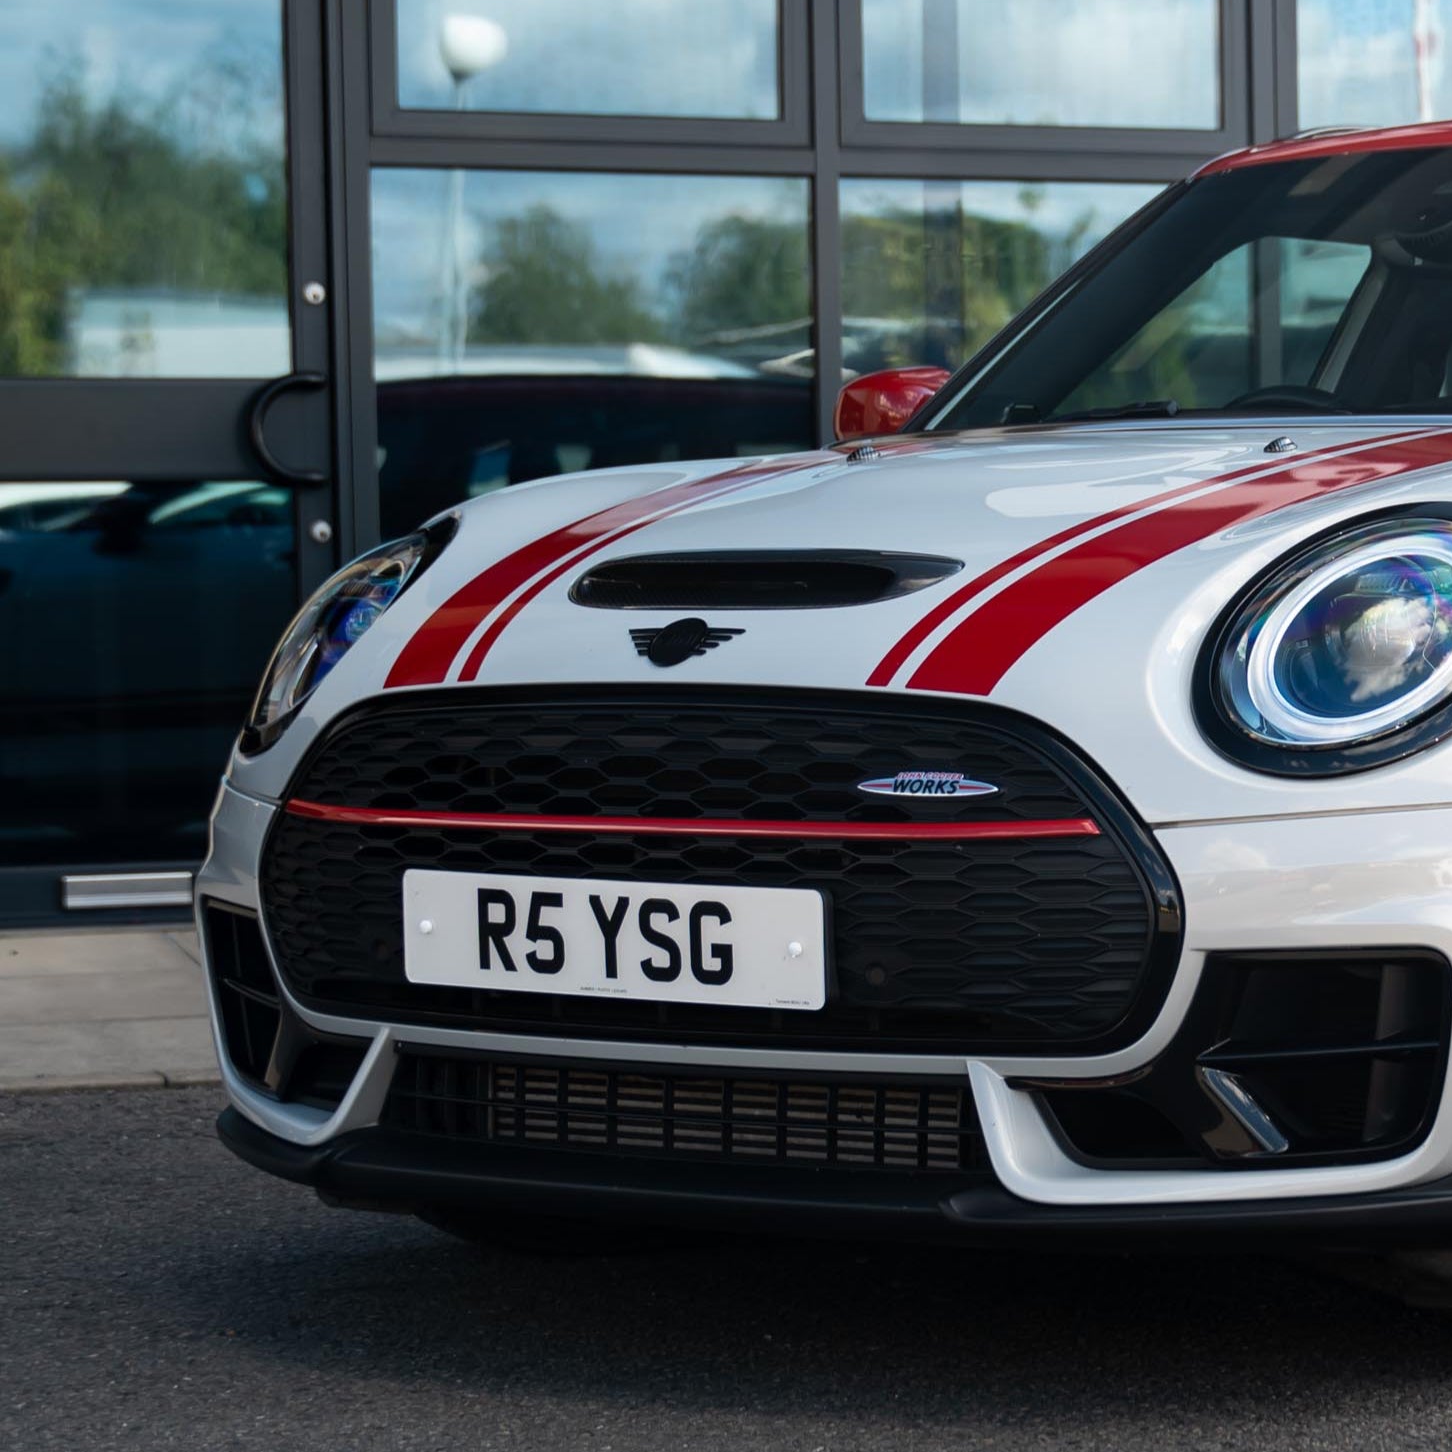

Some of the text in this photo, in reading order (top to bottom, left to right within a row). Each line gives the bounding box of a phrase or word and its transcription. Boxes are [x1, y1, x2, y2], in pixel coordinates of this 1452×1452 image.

[893, 779, 960, 794] WORKS
[477, 887, 734, 986] R5 YSG
